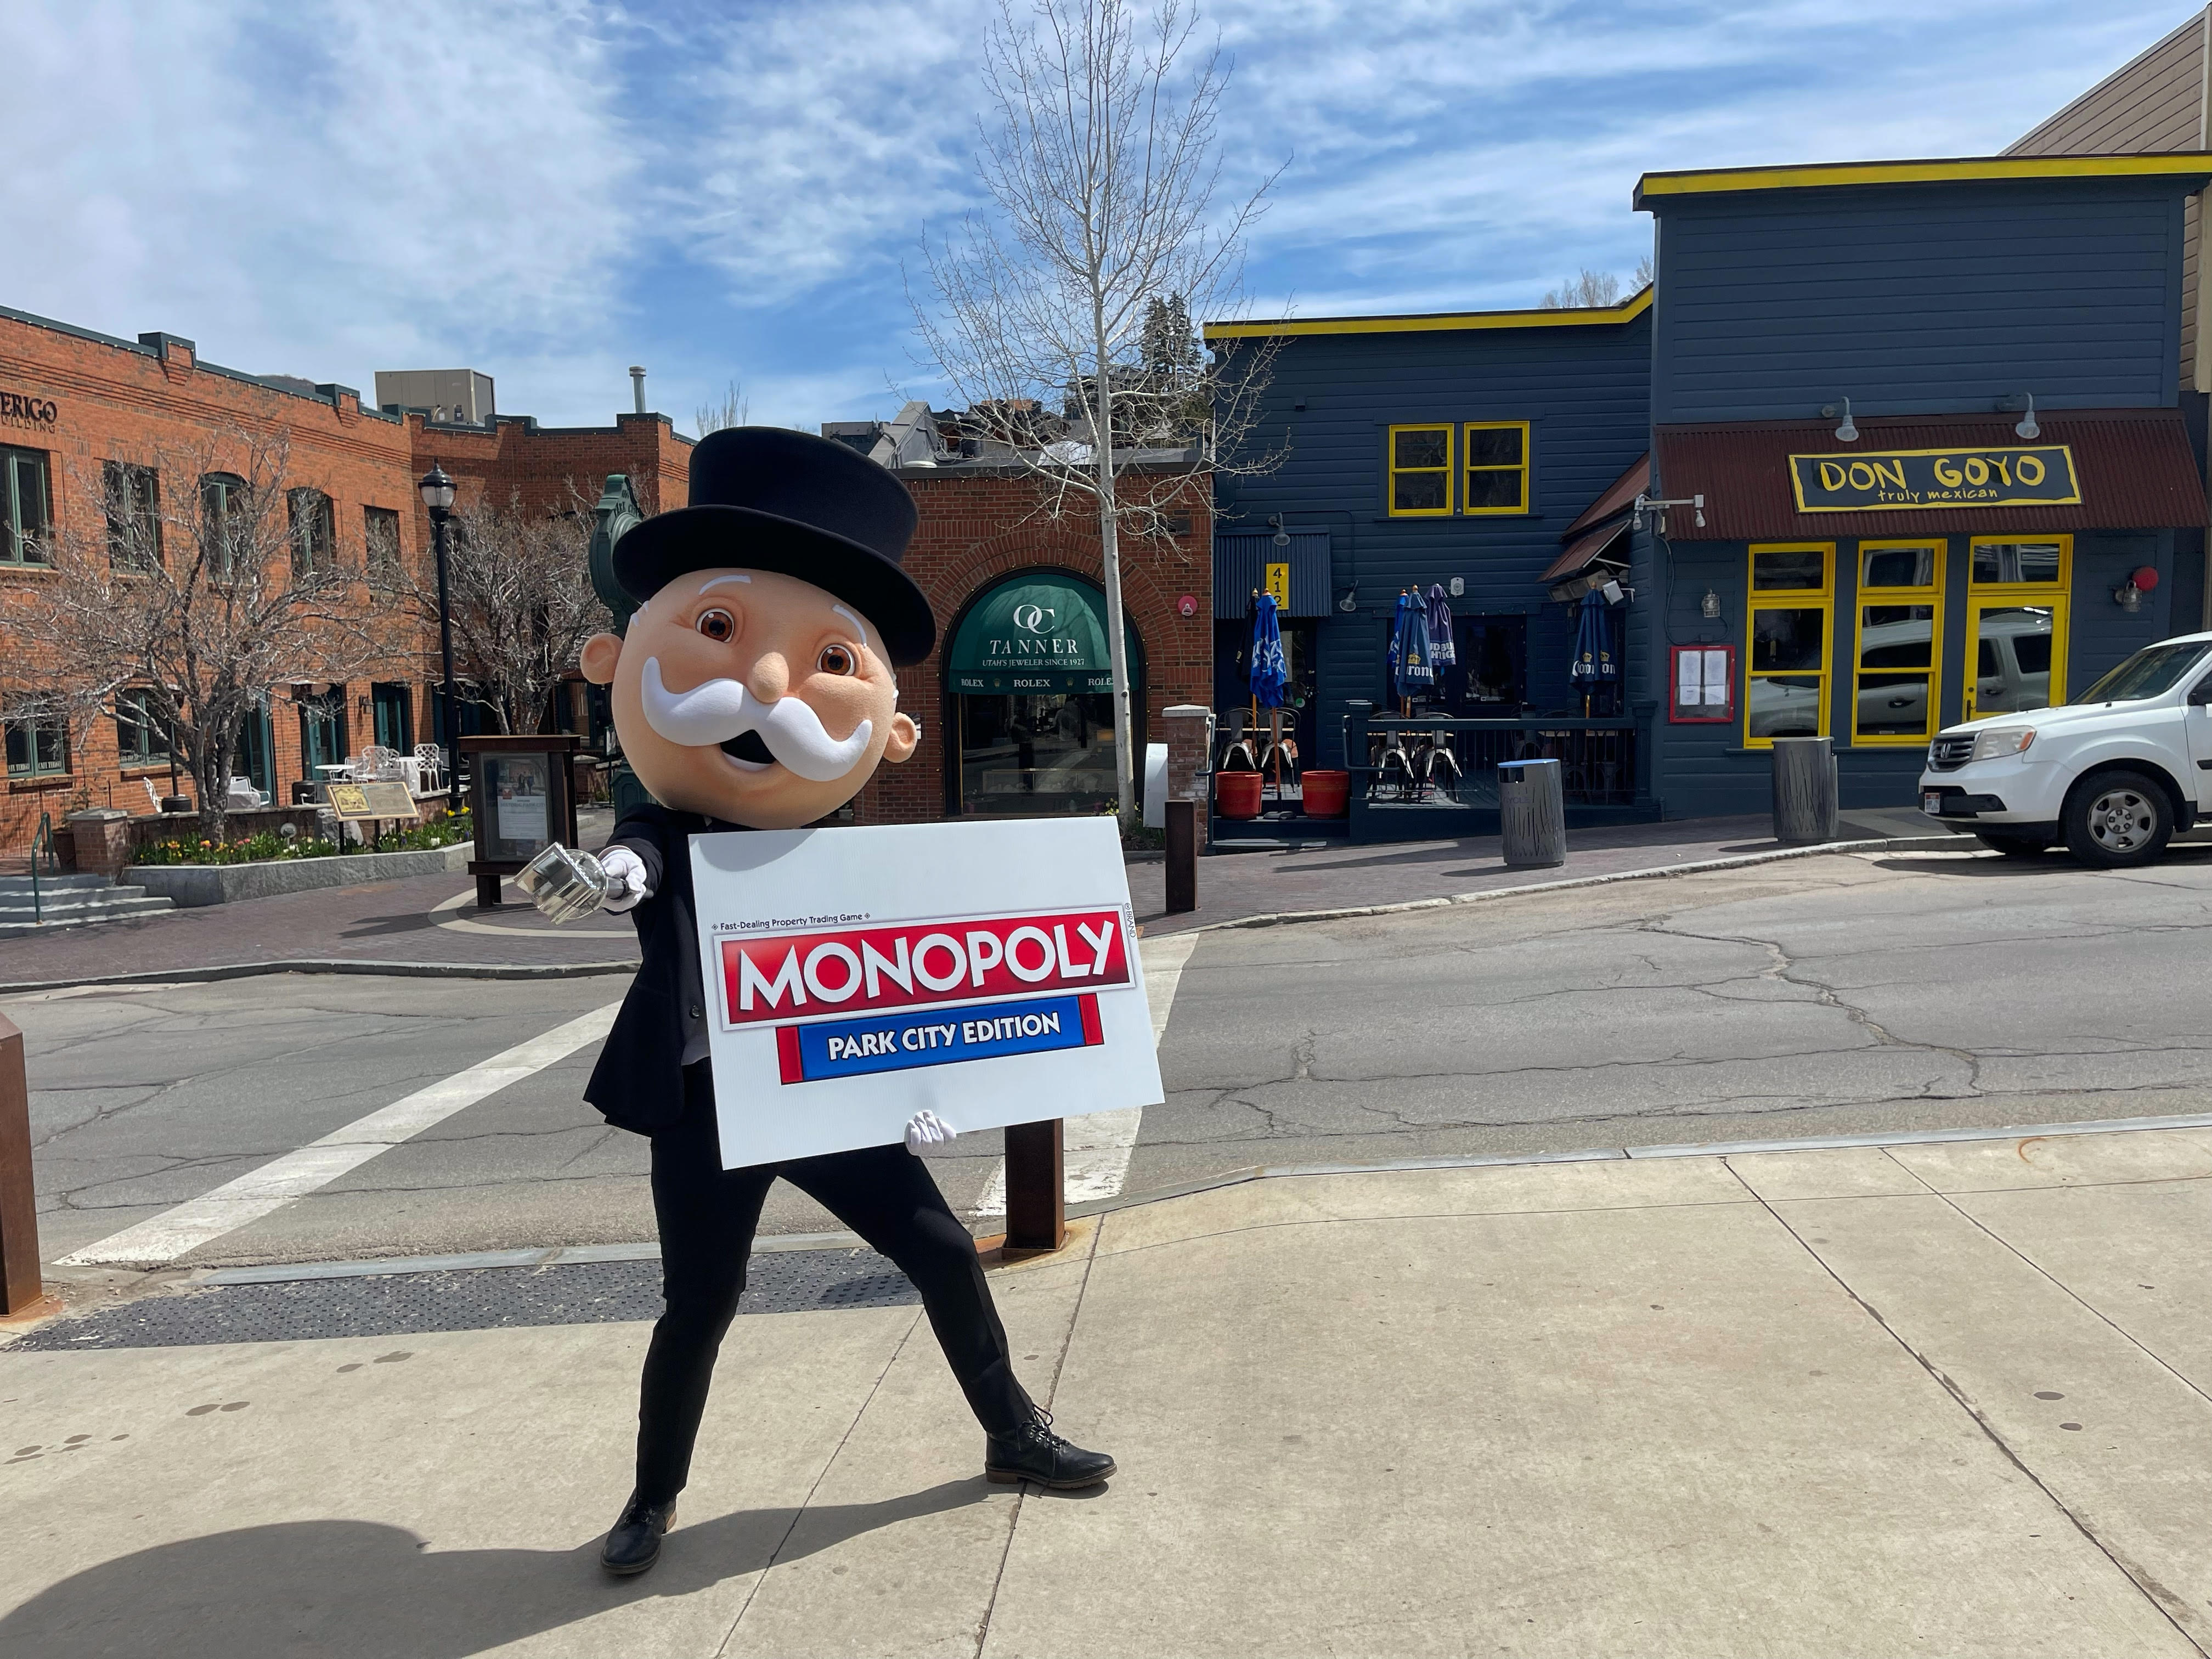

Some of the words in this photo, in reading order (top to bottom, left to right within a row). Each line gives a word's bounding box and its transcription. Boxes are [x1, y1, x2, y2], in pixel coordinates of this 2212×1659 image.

[1820, 459, 1906, 492] DON
[1933, 455, 2046, 488] GOYO
[1878, 489, 1920, 503] truly
[1927, 488, 1997, 499] mexican
[989, 639, 1079, 654] TANNER
[1008, 659, 1044, 668] JEWELER
[1045, 658, 1068, 667] SINCE
[1070, 658, 1085, 666] 1927
[961, 678, 984, 687] ROLEX
[1013, 679, 1051, 687] ROLEX
[1087, 677, 1114, 686] ROLE
[720, 919, 770, 930] Fast-Dealing
[772, 917, 808, 927] Property
[809, 915, 838, 923] Trading
[1126, 911, 1136, 938] BRAND
[740, 920, 1115, 1011] MONOPOLY
[828, 1031, 898, 1060] PARK
[902, 1024, 956, 1050] CITY
[963, 1012, 1060, 1043] EDITION
